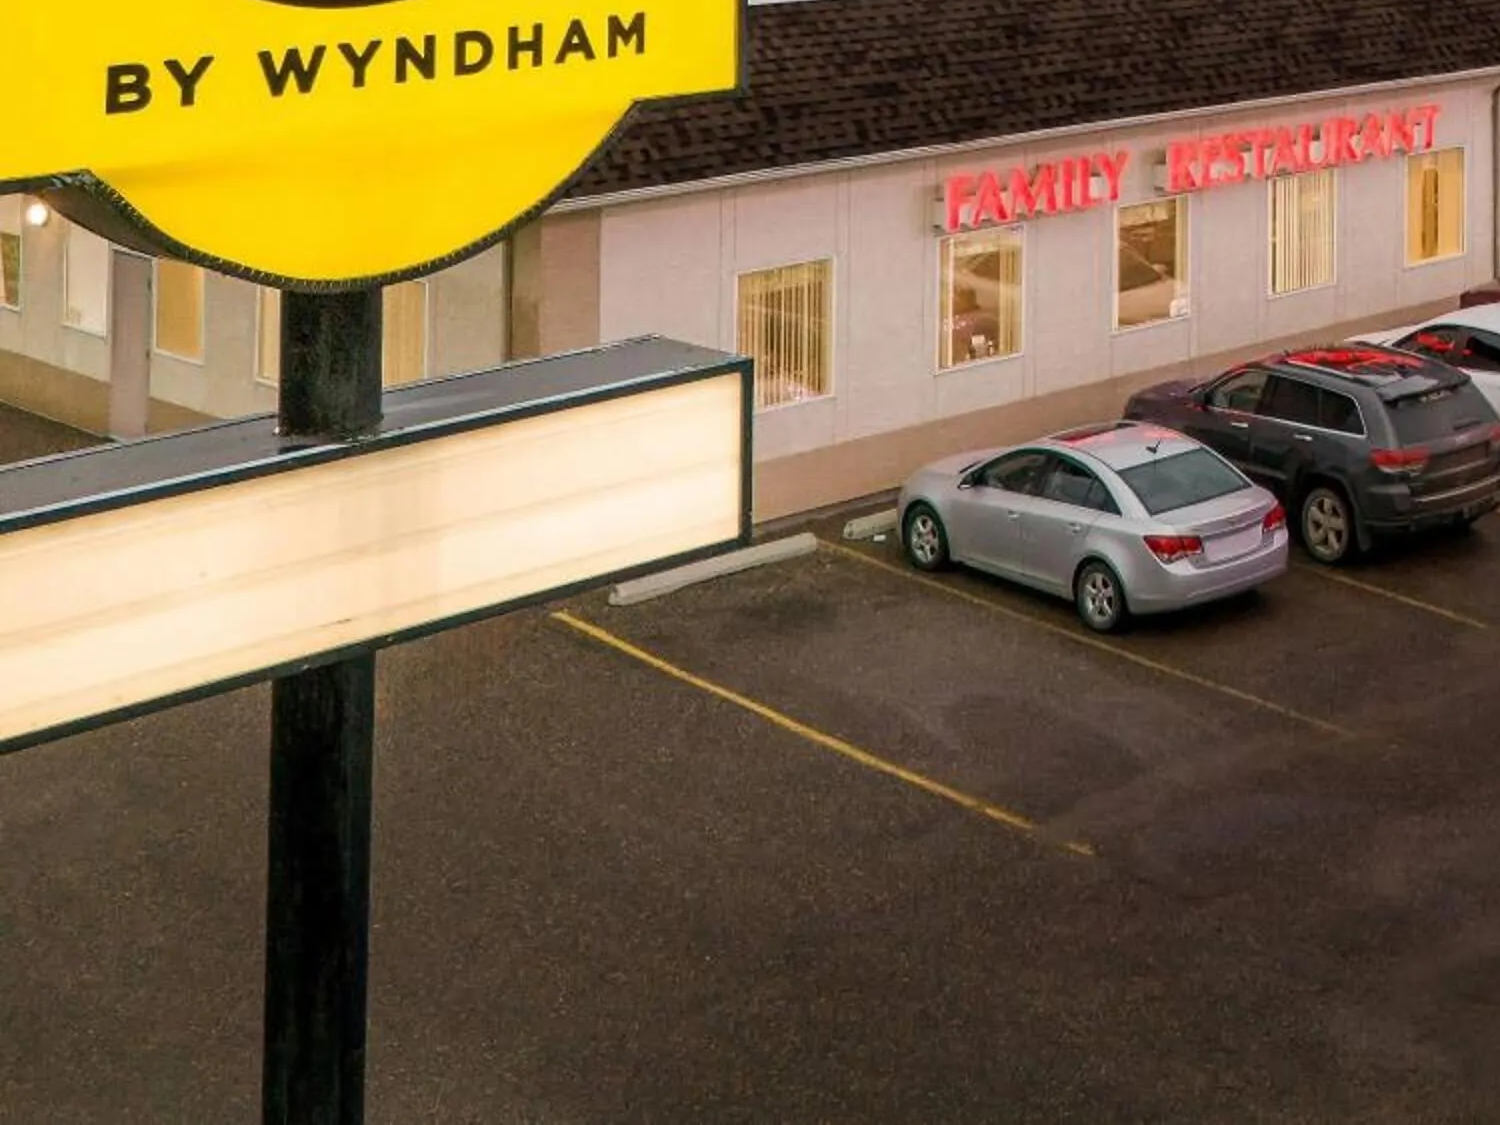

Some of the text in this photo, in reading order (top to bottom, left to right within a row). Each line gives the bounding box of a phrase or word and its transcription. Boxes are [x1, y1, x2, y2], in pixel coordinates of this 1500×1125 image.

[105, 11, 646, 115] BY WYNDHAM
[945, 103, 1440, 234] FAMILY RESTAURANT
